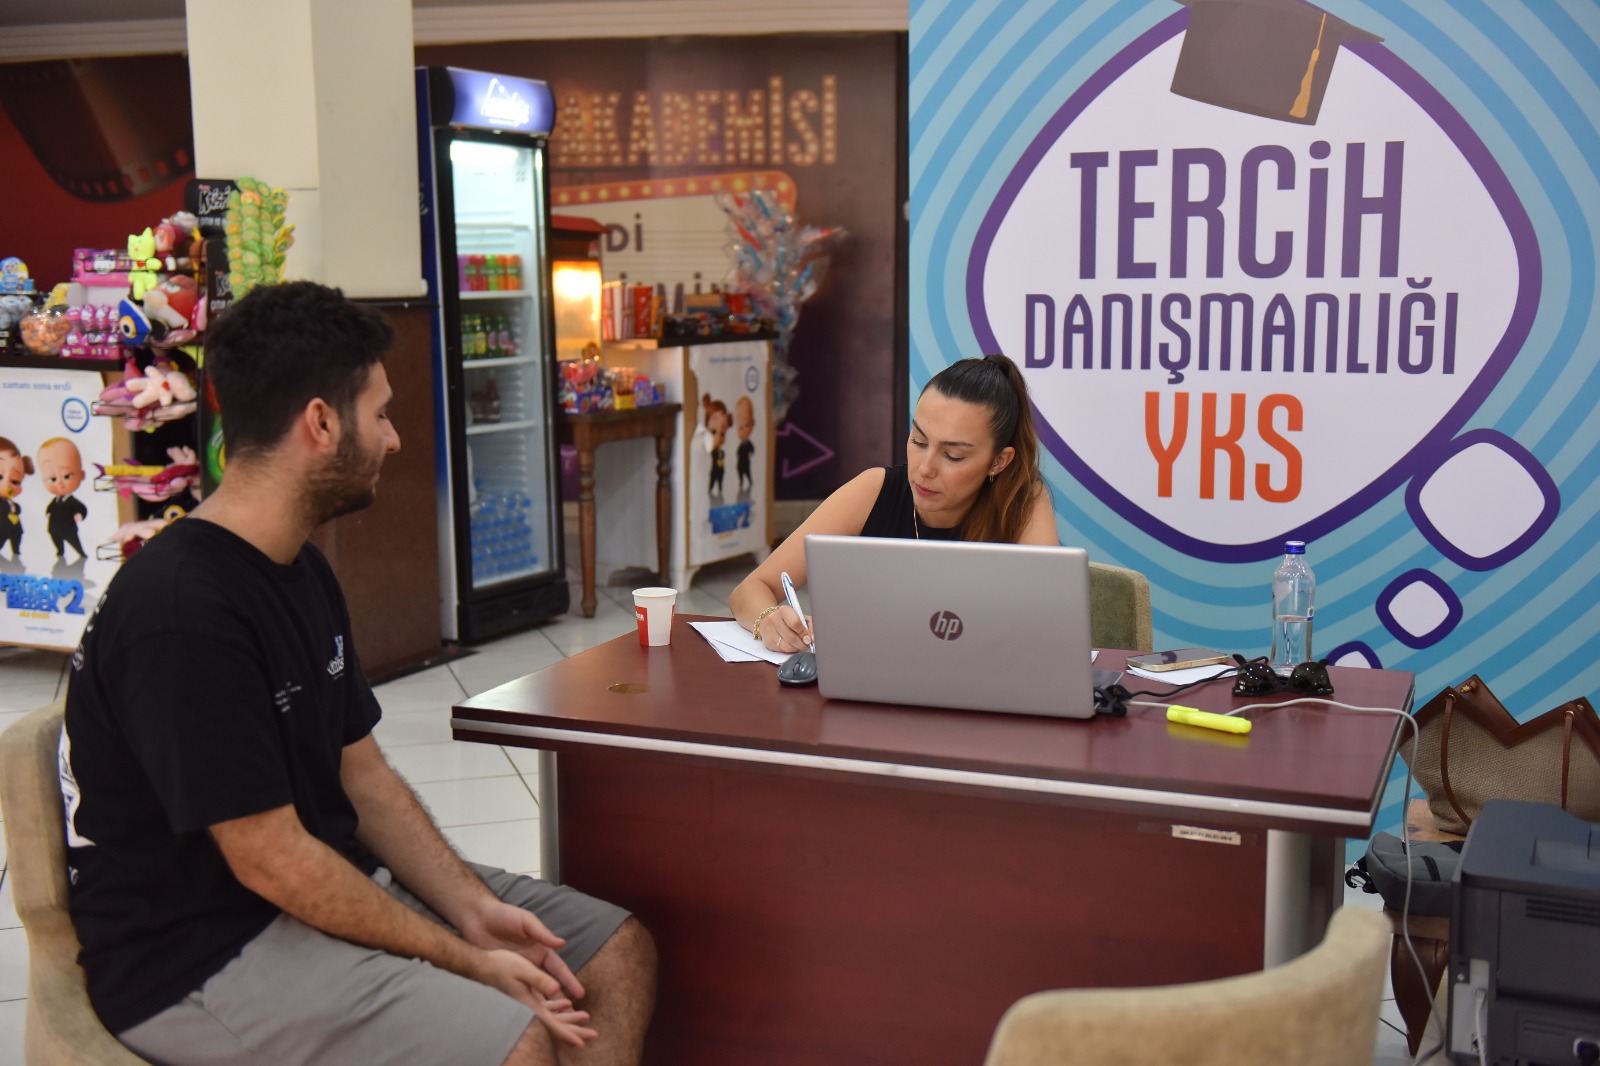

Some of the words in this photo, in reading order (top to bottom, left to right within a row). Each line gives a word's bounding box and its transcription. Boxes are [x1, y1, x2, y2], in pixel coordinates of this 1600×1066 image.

[1069, 139, 1405, 280] TERCİH
[1024, 276, 1459, 385] DANIŞMANLIĞI
[1143, 391, 1305, 503] YKS
[932, 610, 962, 641] hp
